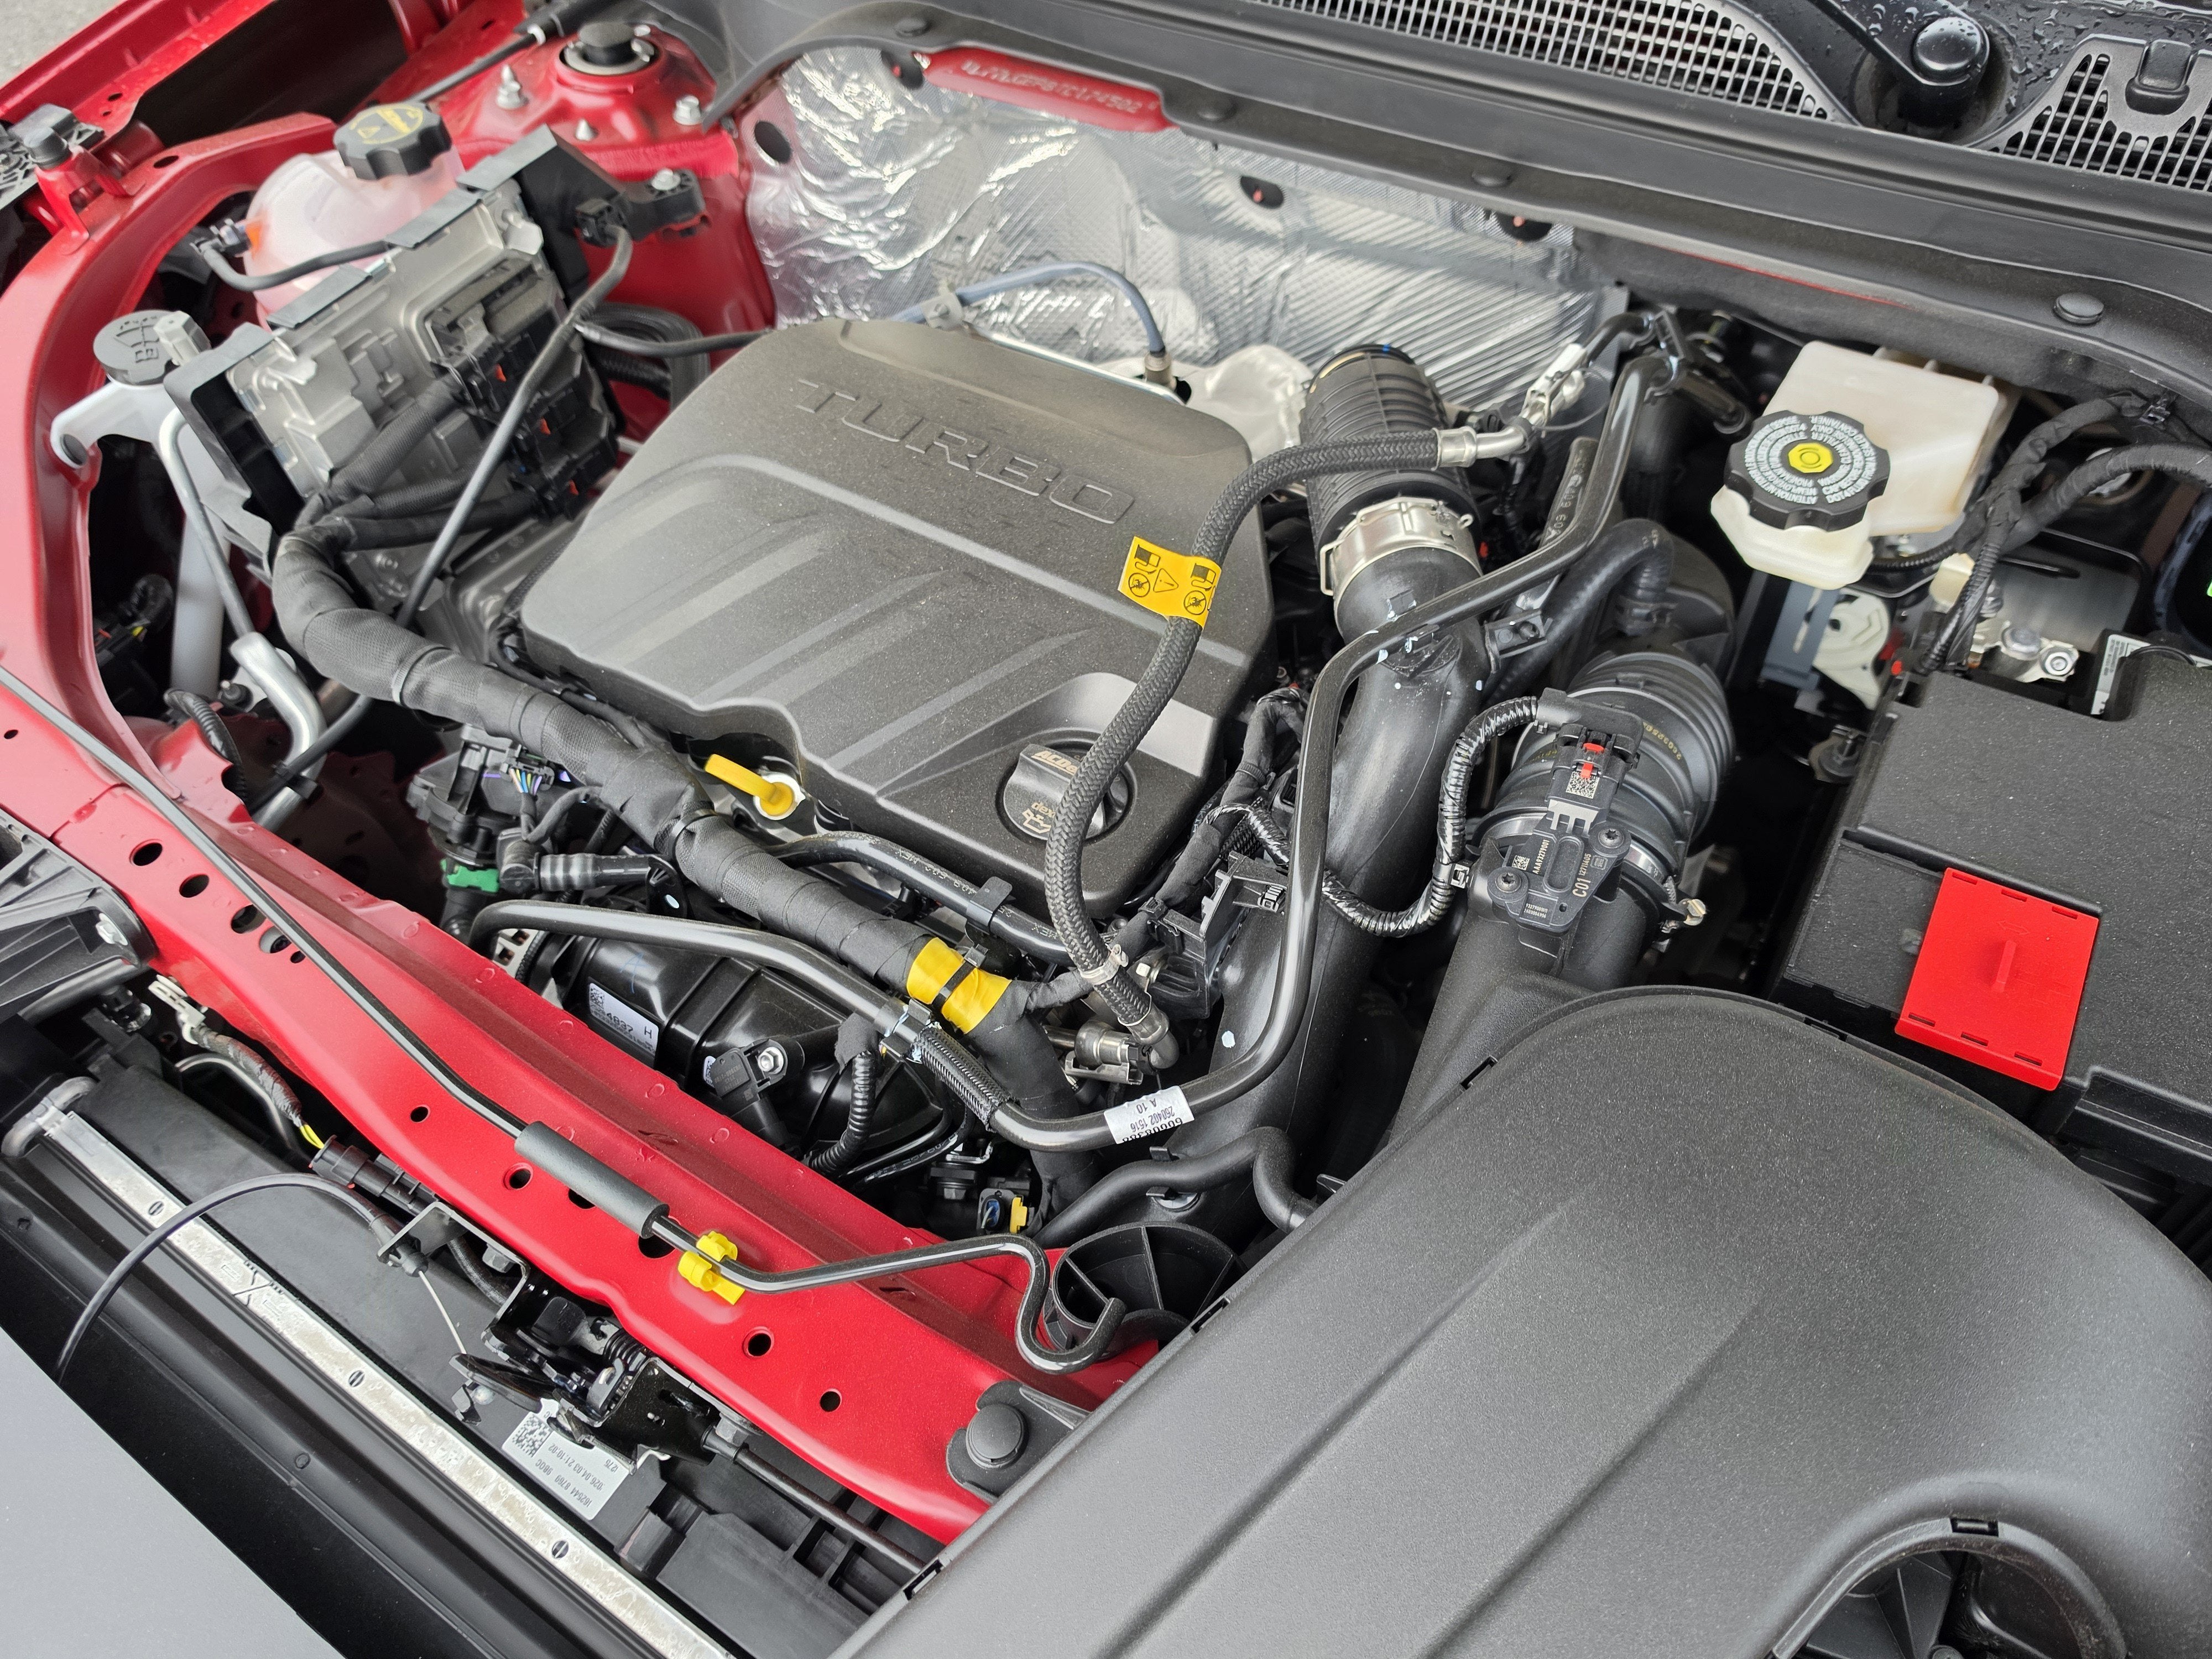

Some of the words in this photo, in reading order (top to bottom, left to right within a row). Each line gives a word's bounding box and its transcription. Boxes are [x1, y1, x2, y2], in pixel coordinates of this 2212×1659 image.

[1811, 422, 1835, 436] ONLY
[1812, 431, 1840, 447] FILLER
[795, 372, 1135, 524] TURBO
[1032, 750, 1078, 772] ACDe
[1031, 802, 1056, 818] dex
[1532, 839, 1550, 874] AAA93279001
[1578, 853, 1592, 876] 12711405
[644, 1026, 653, 1039] H
[1136, 1103, 1148, 1114] 10
[1149, 1098, 1157, 1108] A
[1148, 1106, 1175, 1125] 260402
[1130, 1118, 1148, 1133] 1516
[547, 1442, 575, 1468] 21:10:02
